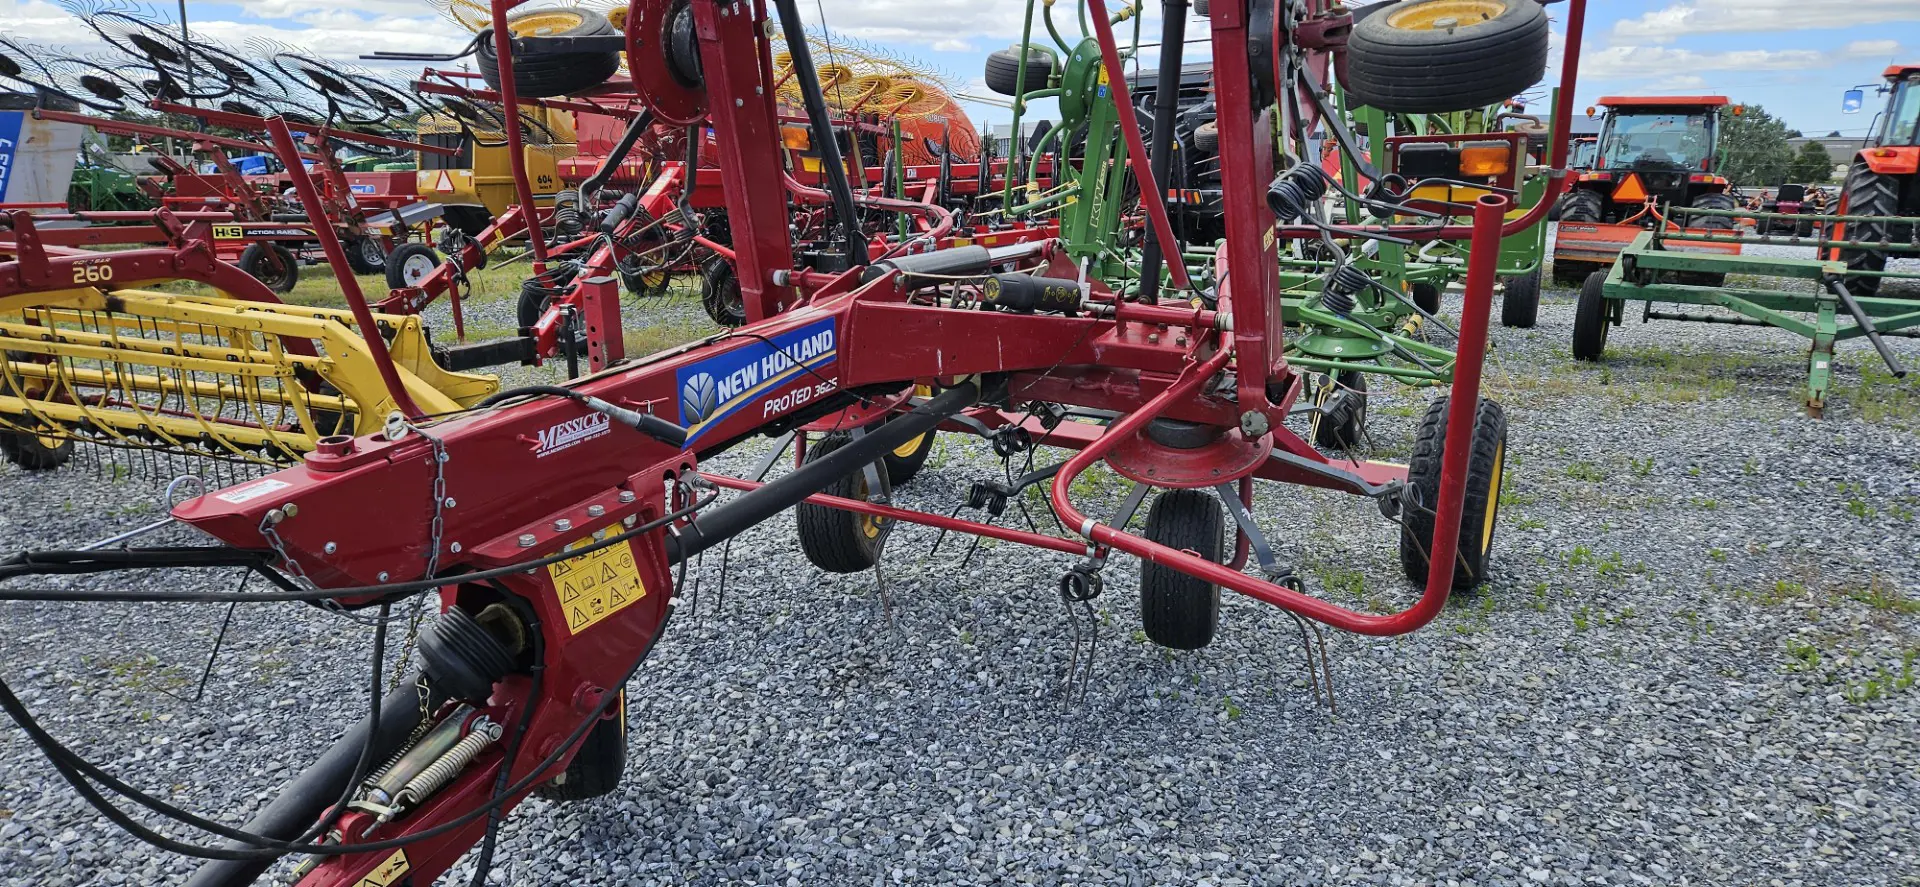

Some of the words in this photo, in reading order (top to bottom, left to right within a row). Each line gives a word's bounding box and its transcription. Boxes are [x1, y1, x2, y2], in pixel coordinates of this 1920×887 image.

[537, 174, 553, 184] 604
[215, 228, 241, 237] H&S
[72, 264, 113, 284] 260
[717, 361, 758, 404] NEW
[761, 329, 833, 380] HOLLAND
[763, 386, 811, 418] PROTED
[813, 377, 838, 397] 3625
[536, 411, 610, 453] MESSICK'S
